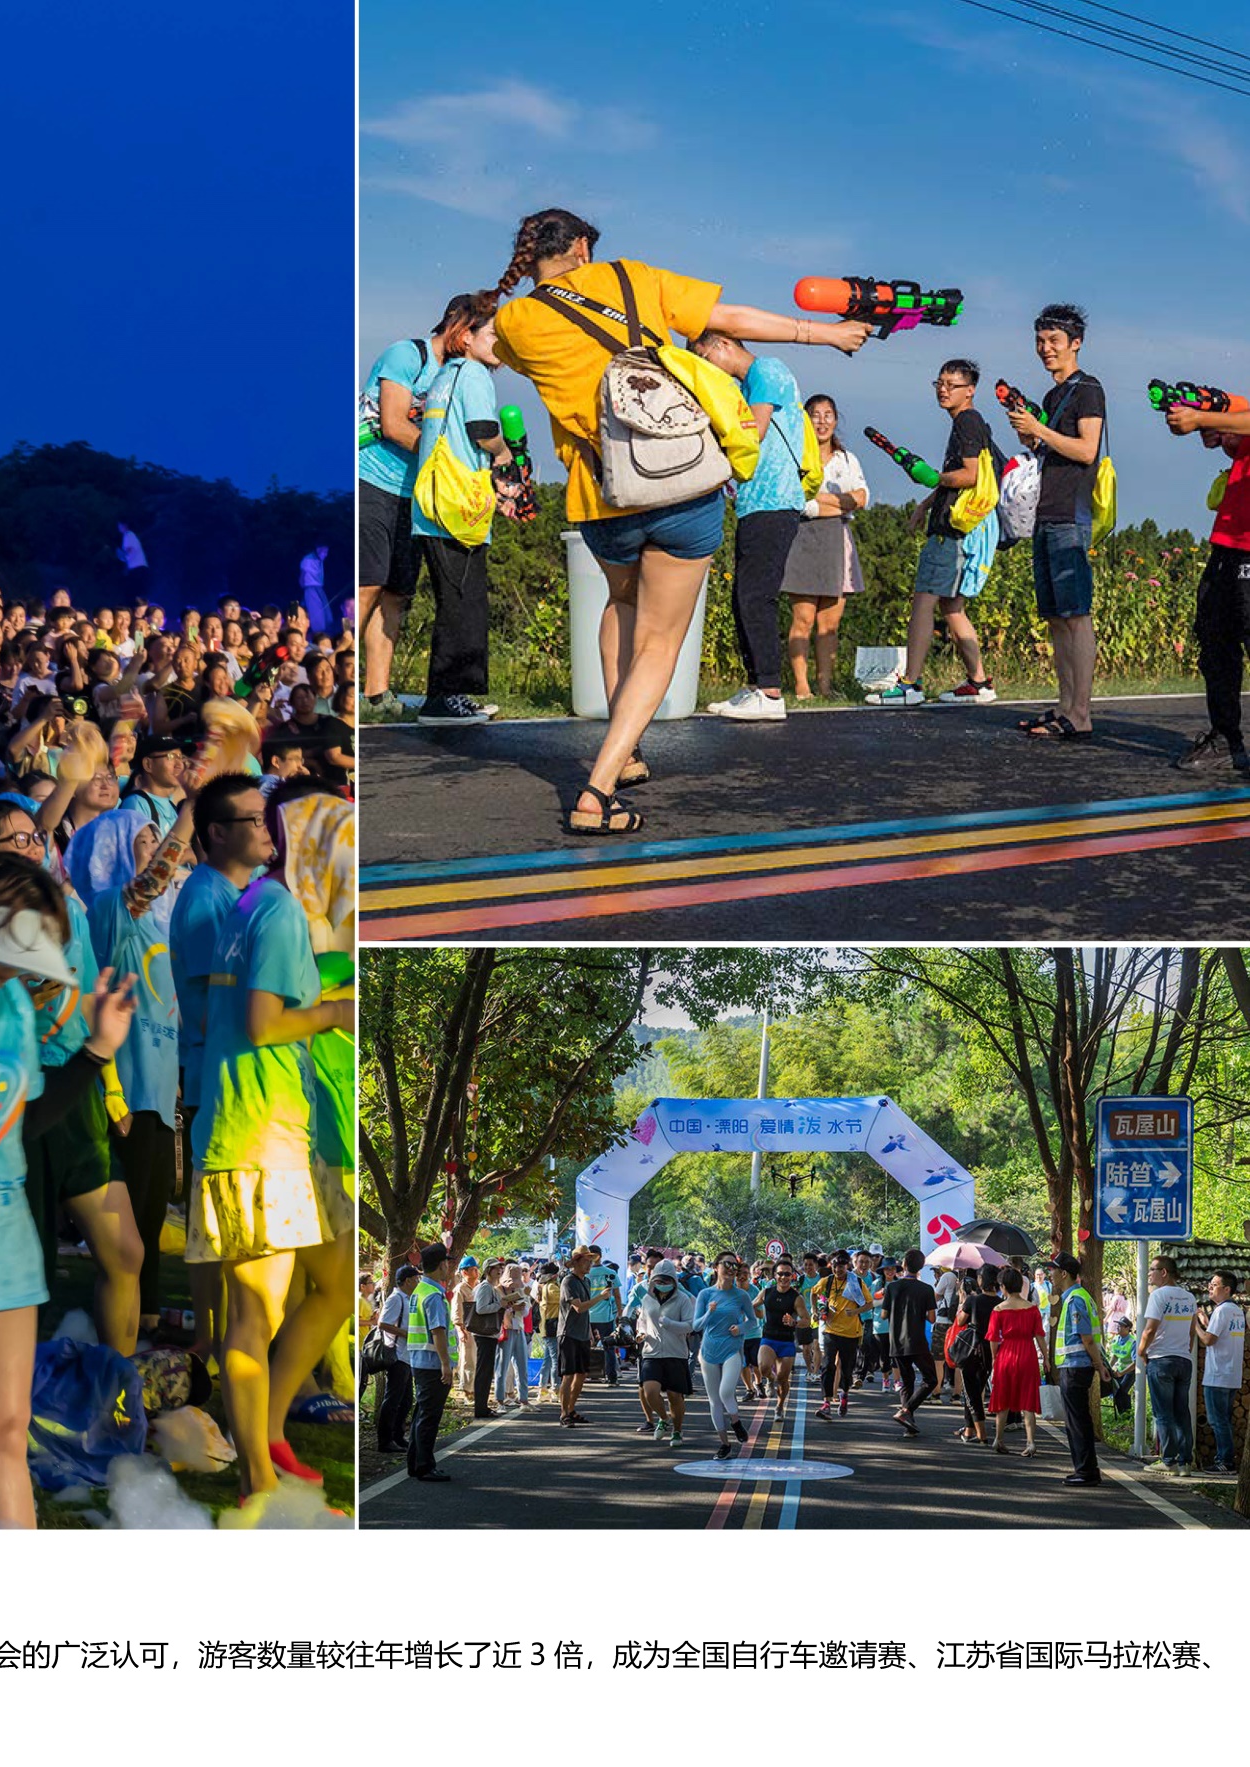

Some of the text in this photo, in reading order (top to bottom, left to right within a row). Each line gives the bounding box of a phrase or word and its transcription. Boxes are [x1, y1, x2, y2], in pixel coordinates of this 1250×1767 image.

[1114, 1113, 1176, 1136] 瓦屋山
[1105, 1161, 1153, 1188] 陆笪
[1133, 1197, 1182, 1223] 瓦屋山
[770, 1245, 781, 1255] 30
